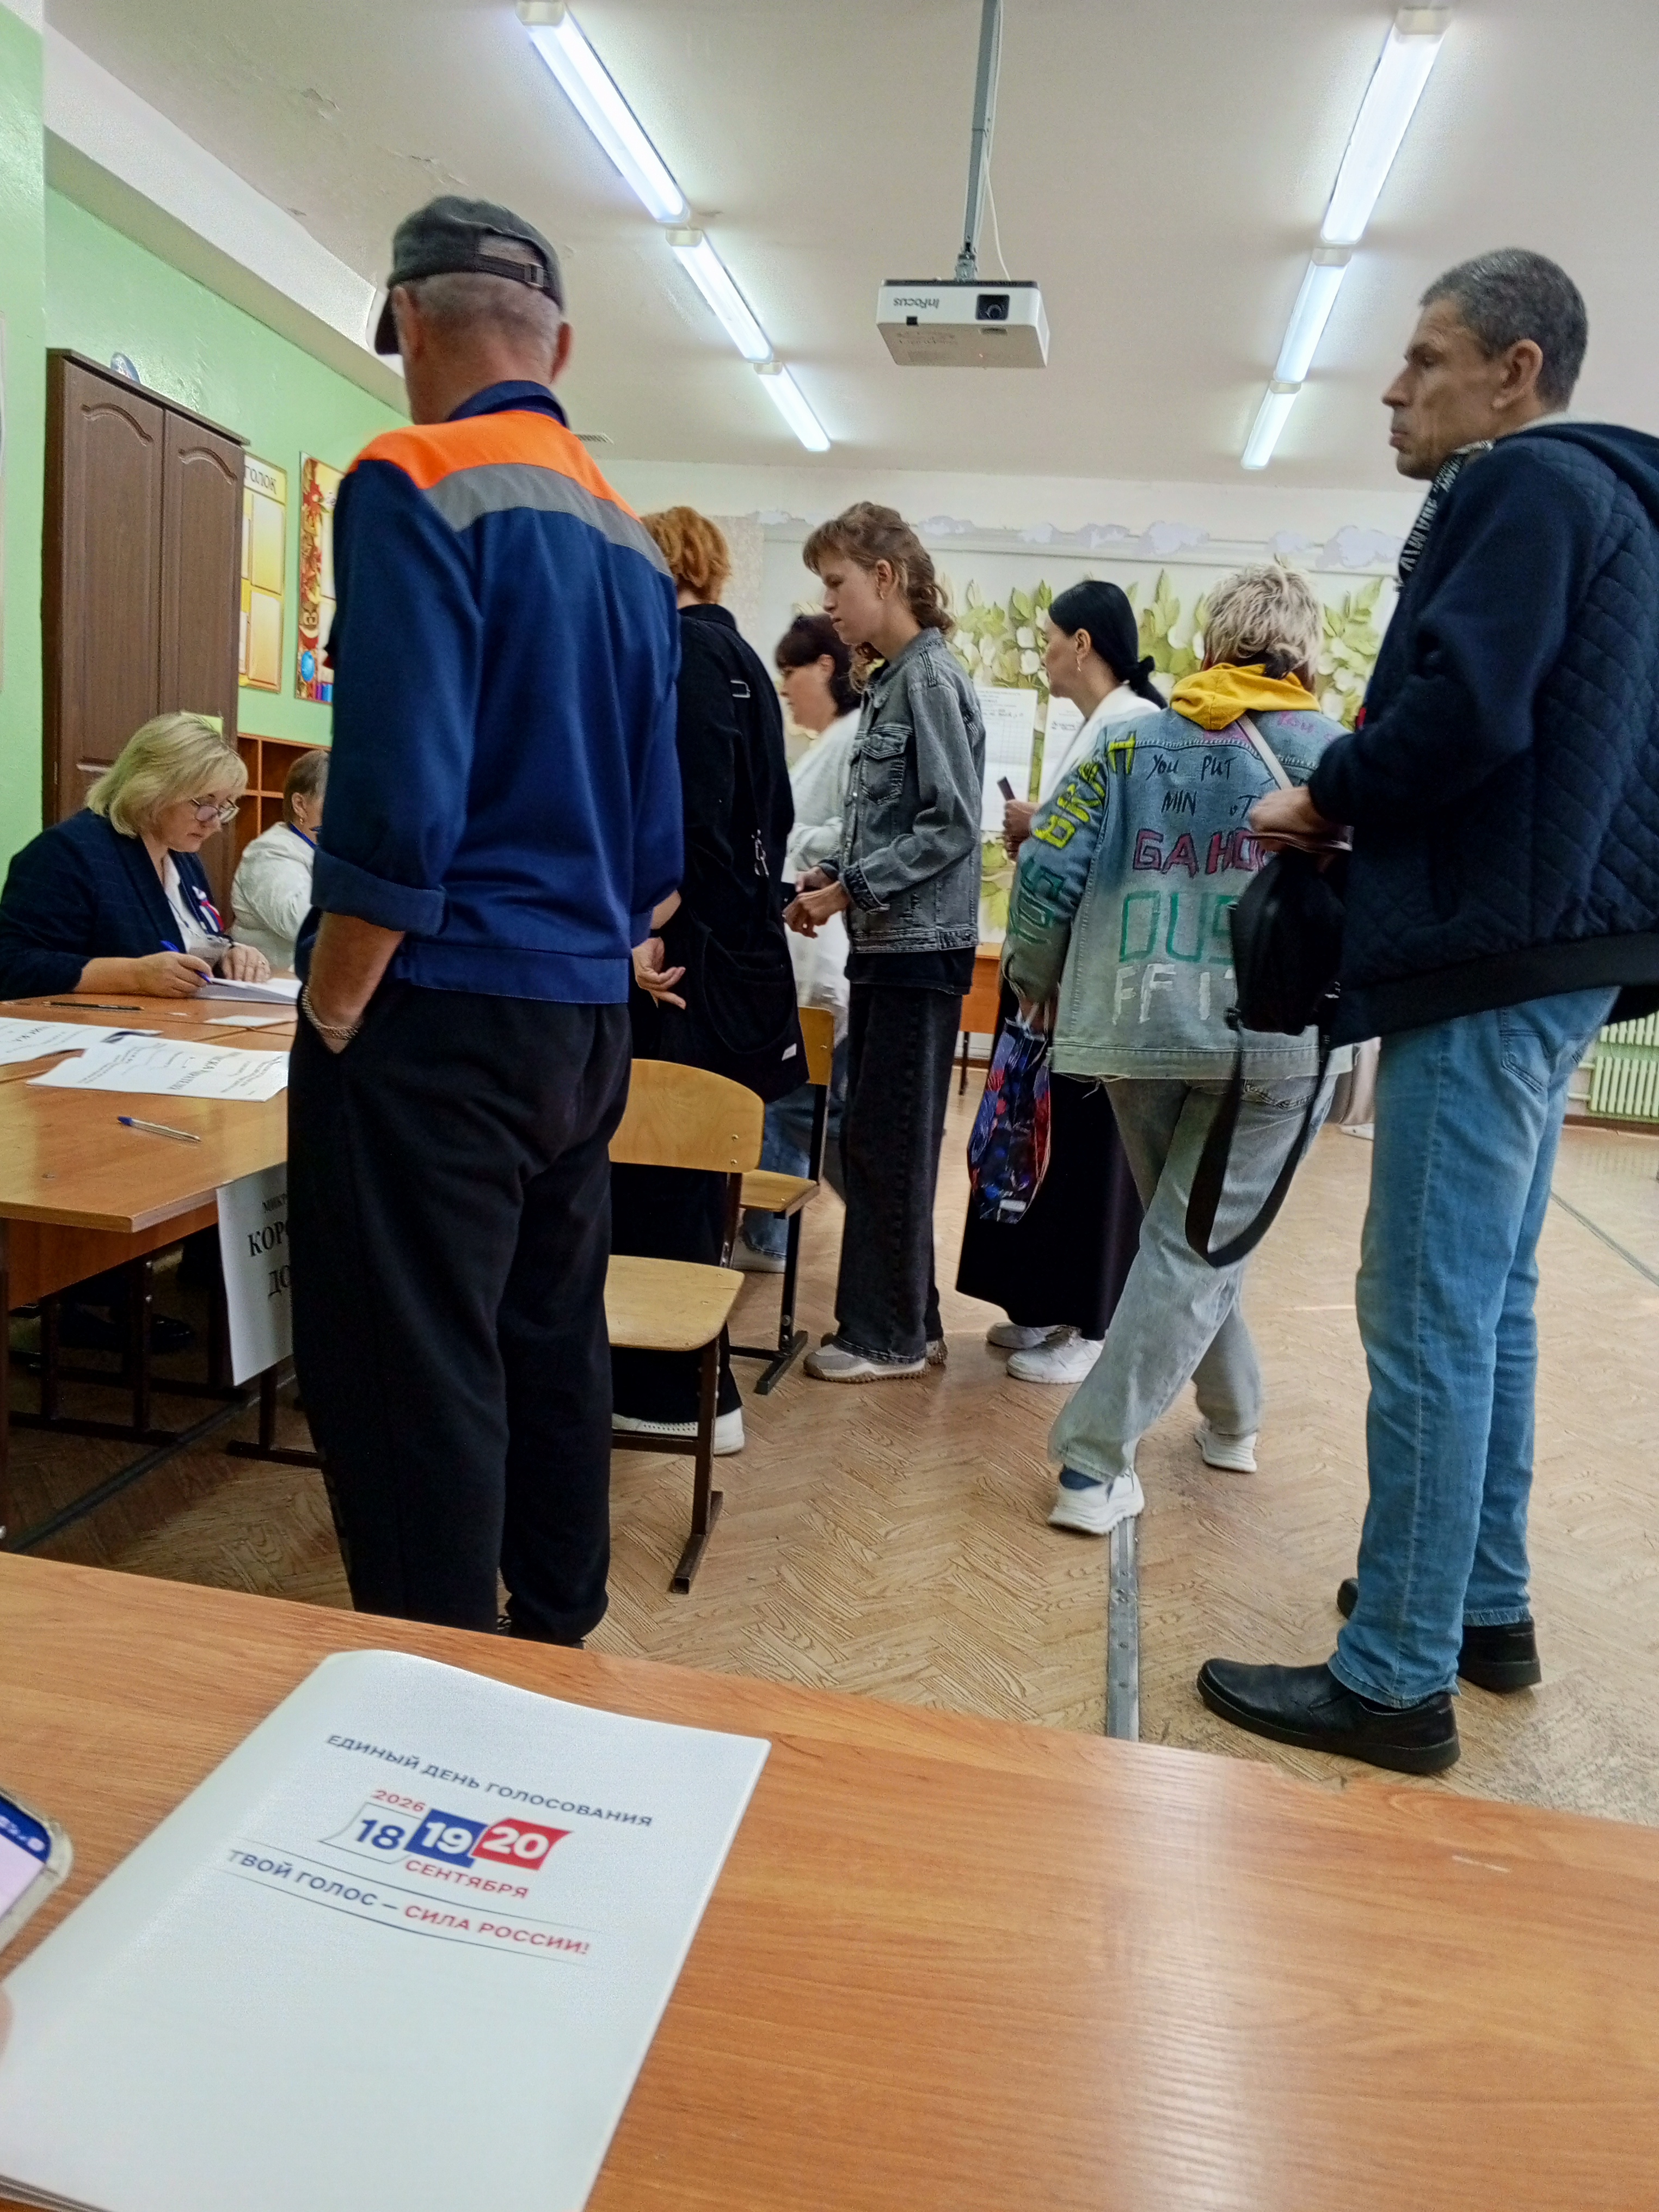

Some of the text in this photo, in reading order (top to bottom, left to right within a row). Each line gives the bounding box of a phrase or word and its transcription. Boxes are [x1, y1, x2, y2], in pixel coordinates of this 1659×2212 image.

[327, 1735, 653, 1827] ЕДИНЫЙ ДЕНЬ ГОЛОСОВАНИЯ
[371, 1789, 426, 1812] 2026
[357, 1819, 549, 1859] 18 19 20
[405, 1859, 529, 1899] СЕНТЯБРЯ
[228, 1849, 292, 1879] ТВОЙ
[294, 1872, 378, 1907] ГОЛОС
[404, 1905, 470, 1931] СИЛА
[477, 1922, 590, 1956] РОССИИ!
